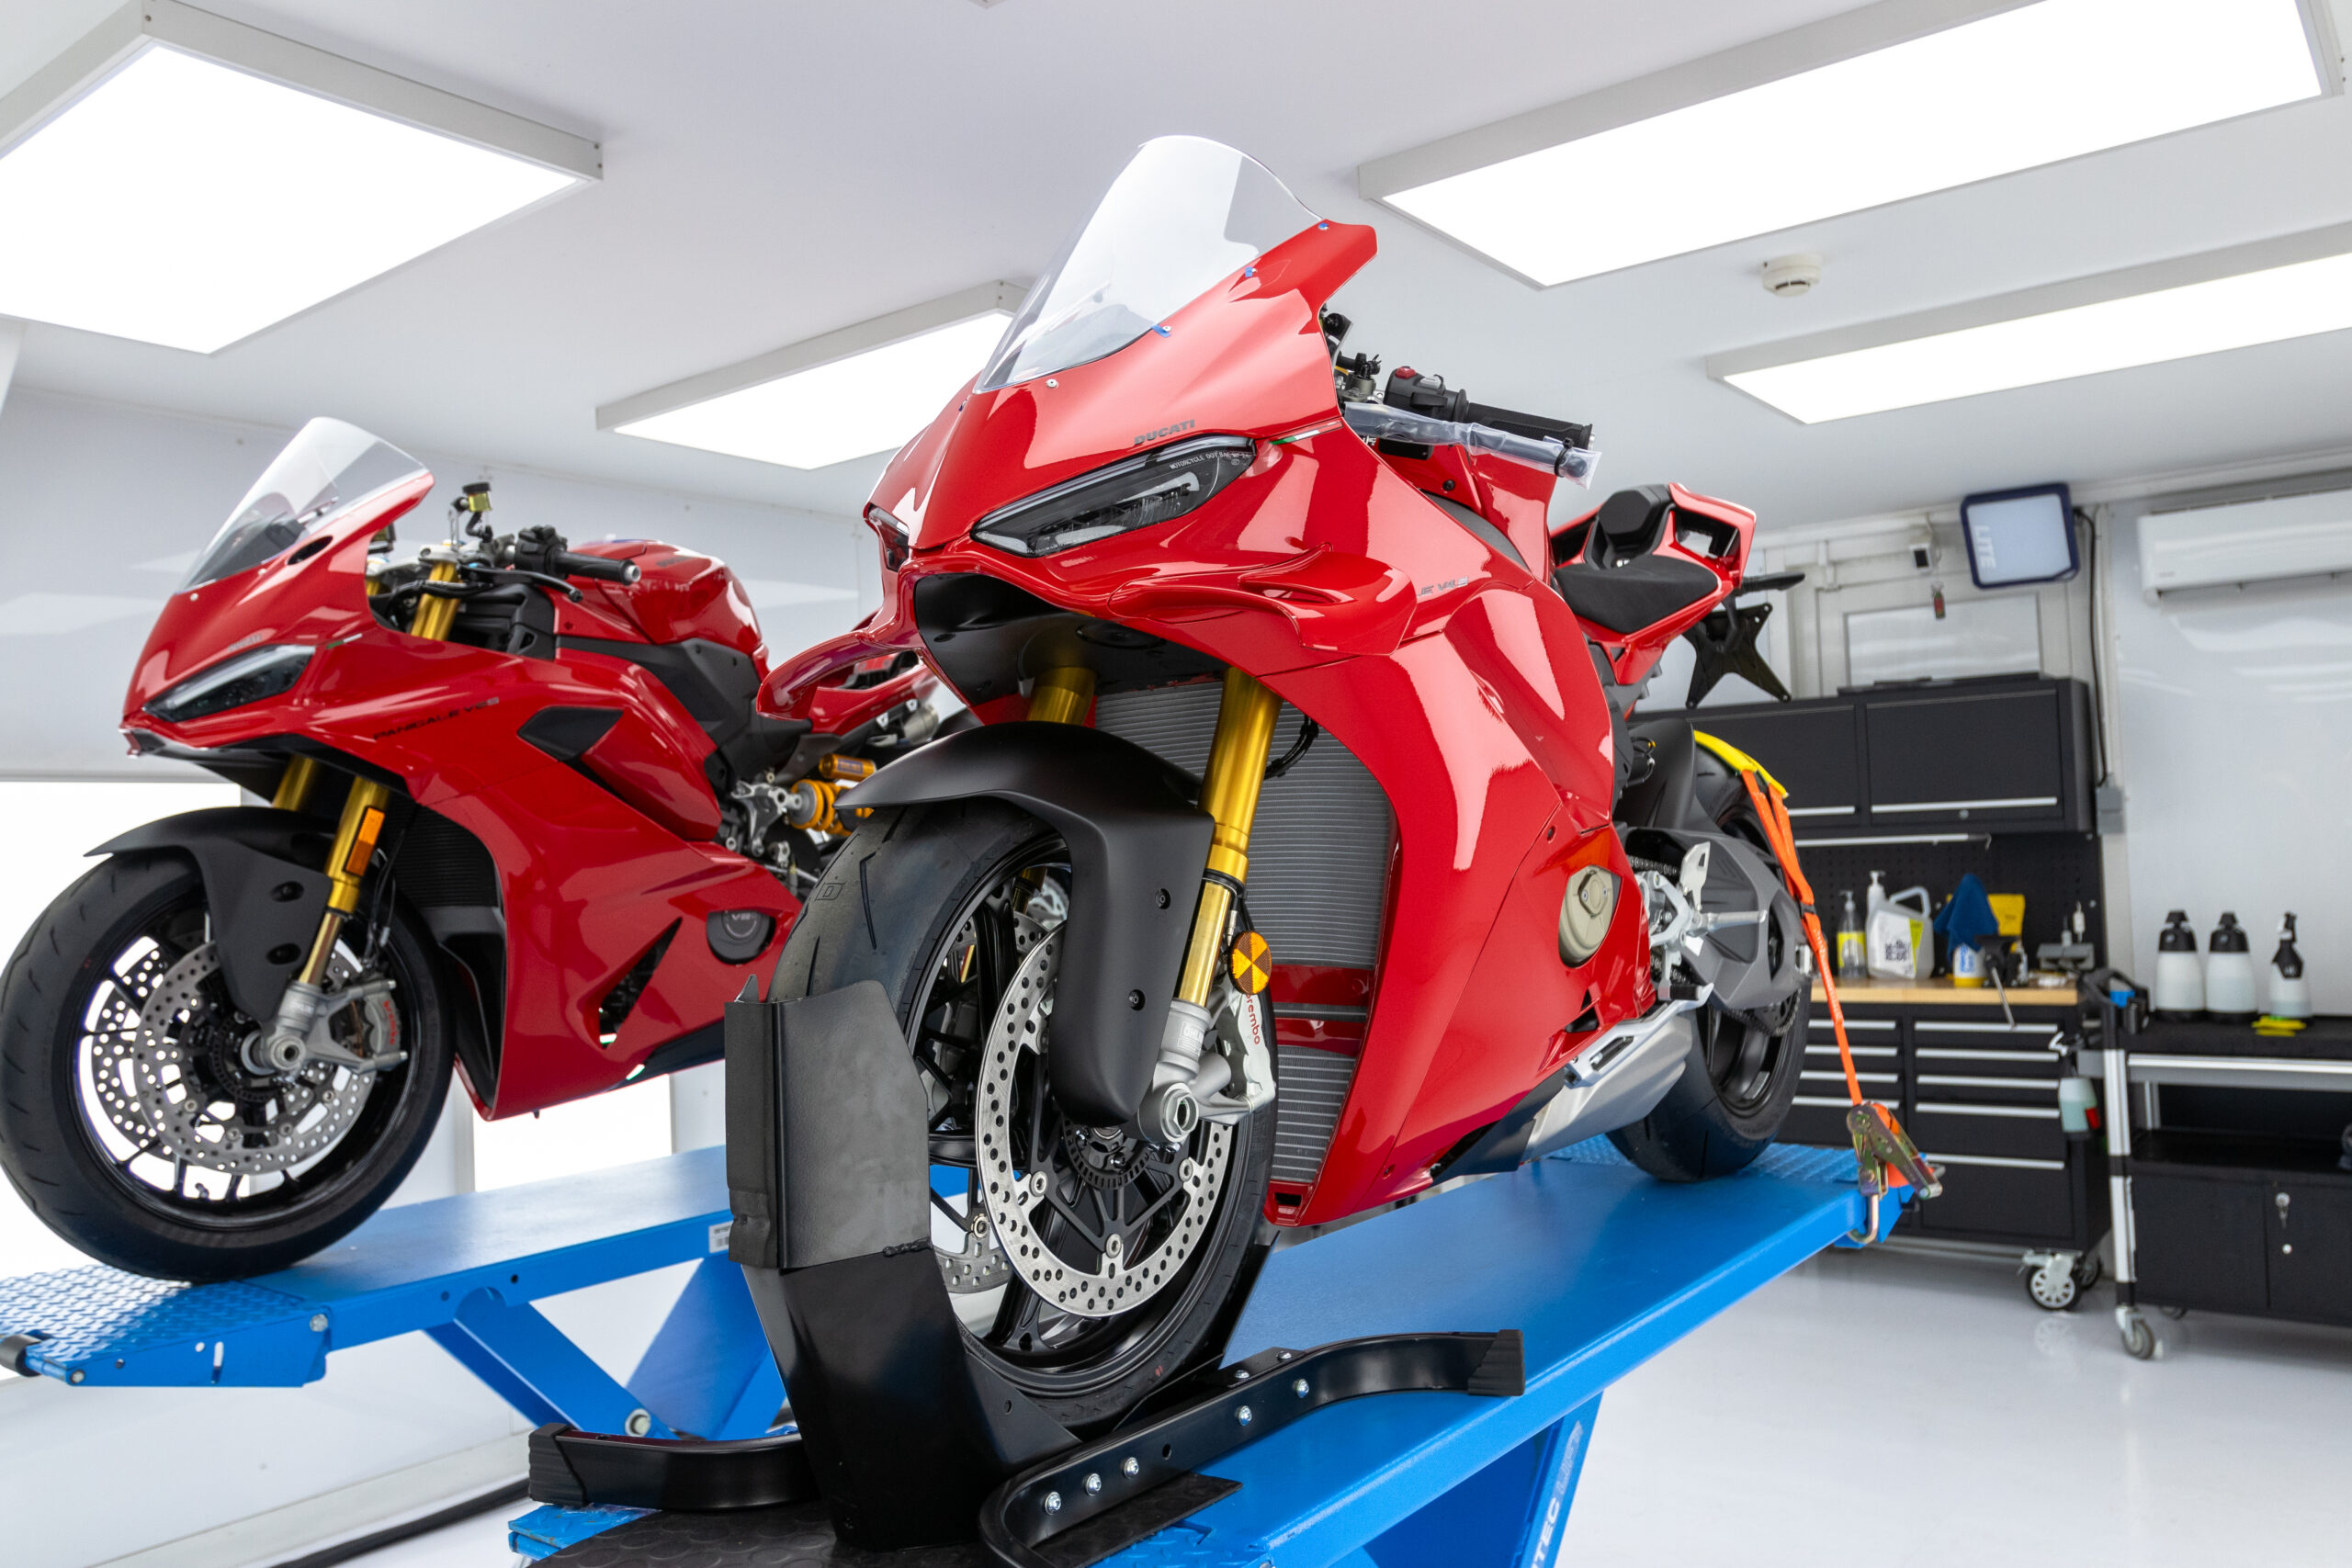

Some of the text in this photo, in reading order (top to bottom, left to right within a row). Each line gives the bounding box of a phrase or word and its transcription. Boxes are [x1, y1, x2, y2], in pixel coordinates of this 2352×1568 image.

[1135, 419, 1195, 446] DUCATI
[1170, 454, 1205, 469] MOTORCYCLE
[1974, 525, 1996, 569] LITE
